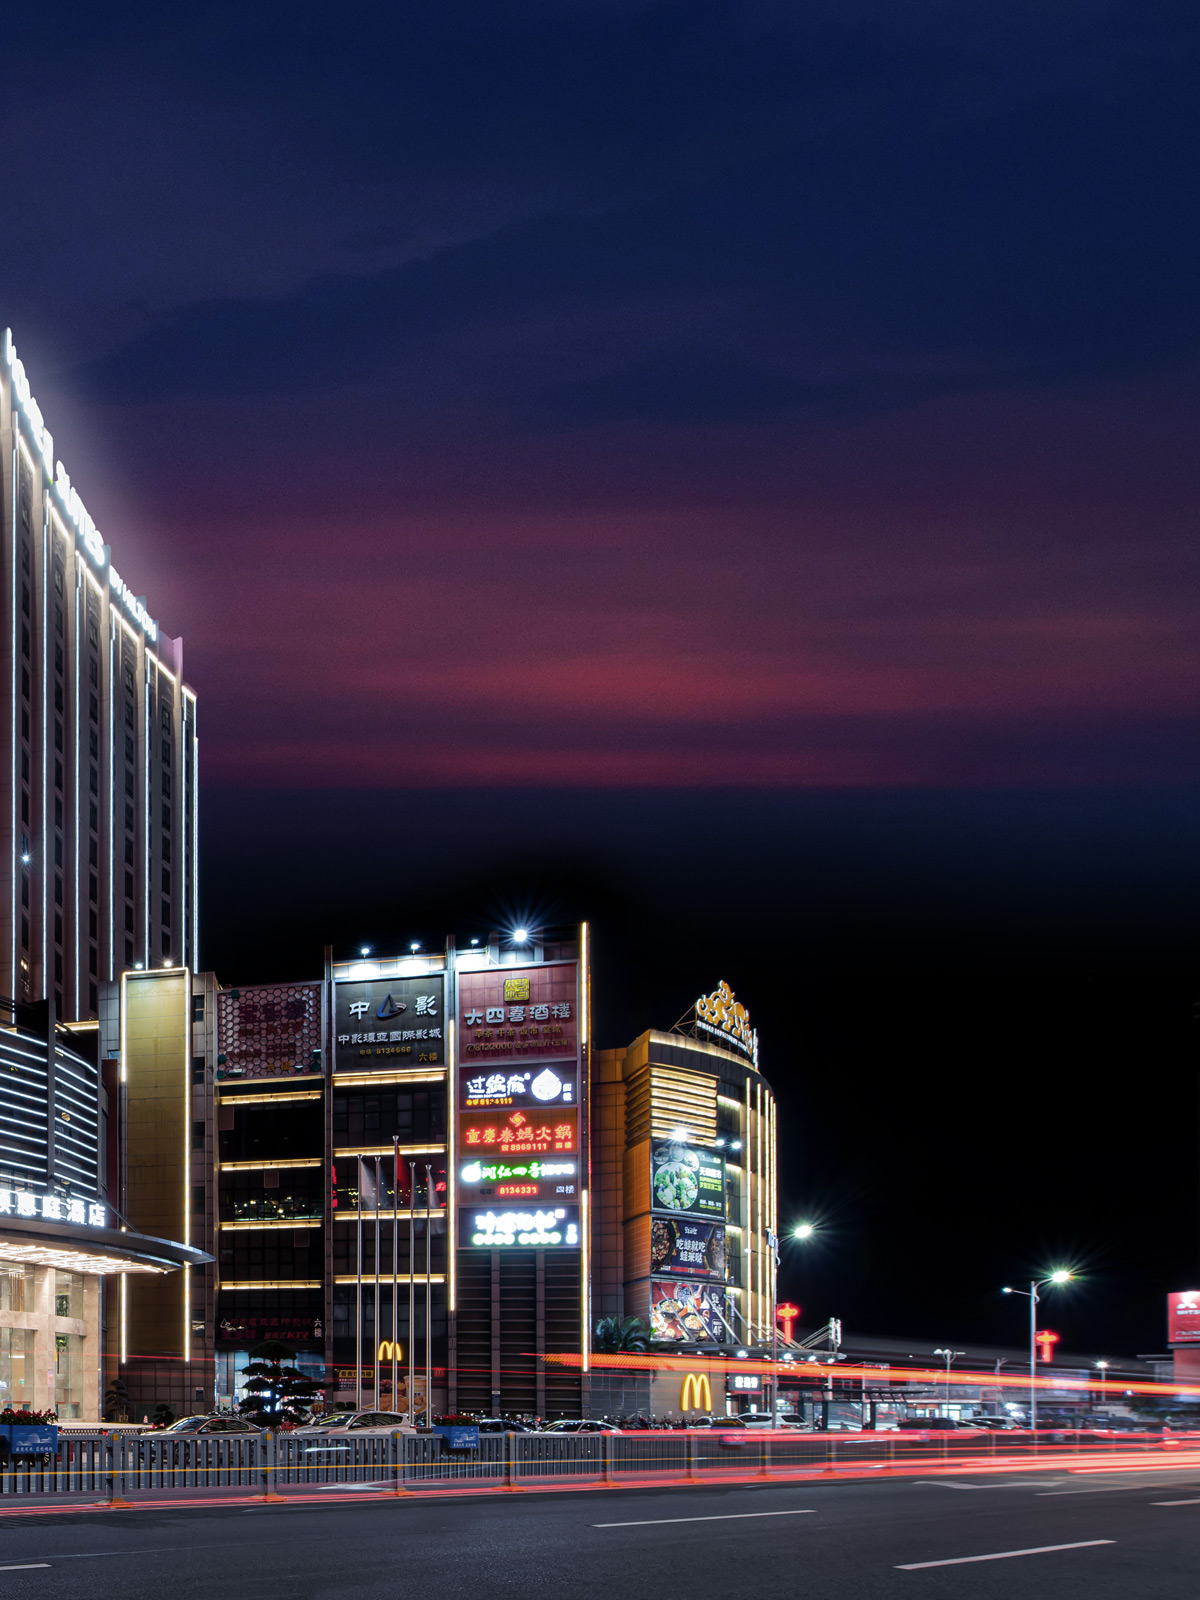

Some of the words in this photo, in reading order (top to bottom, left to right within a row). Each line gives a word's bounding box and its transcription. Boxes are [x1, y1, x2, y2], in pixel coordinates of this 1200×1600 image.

[464, 1003, 571, 1026] 大四喜酒楼
[500, 1186, 537, 1195] 8134333
